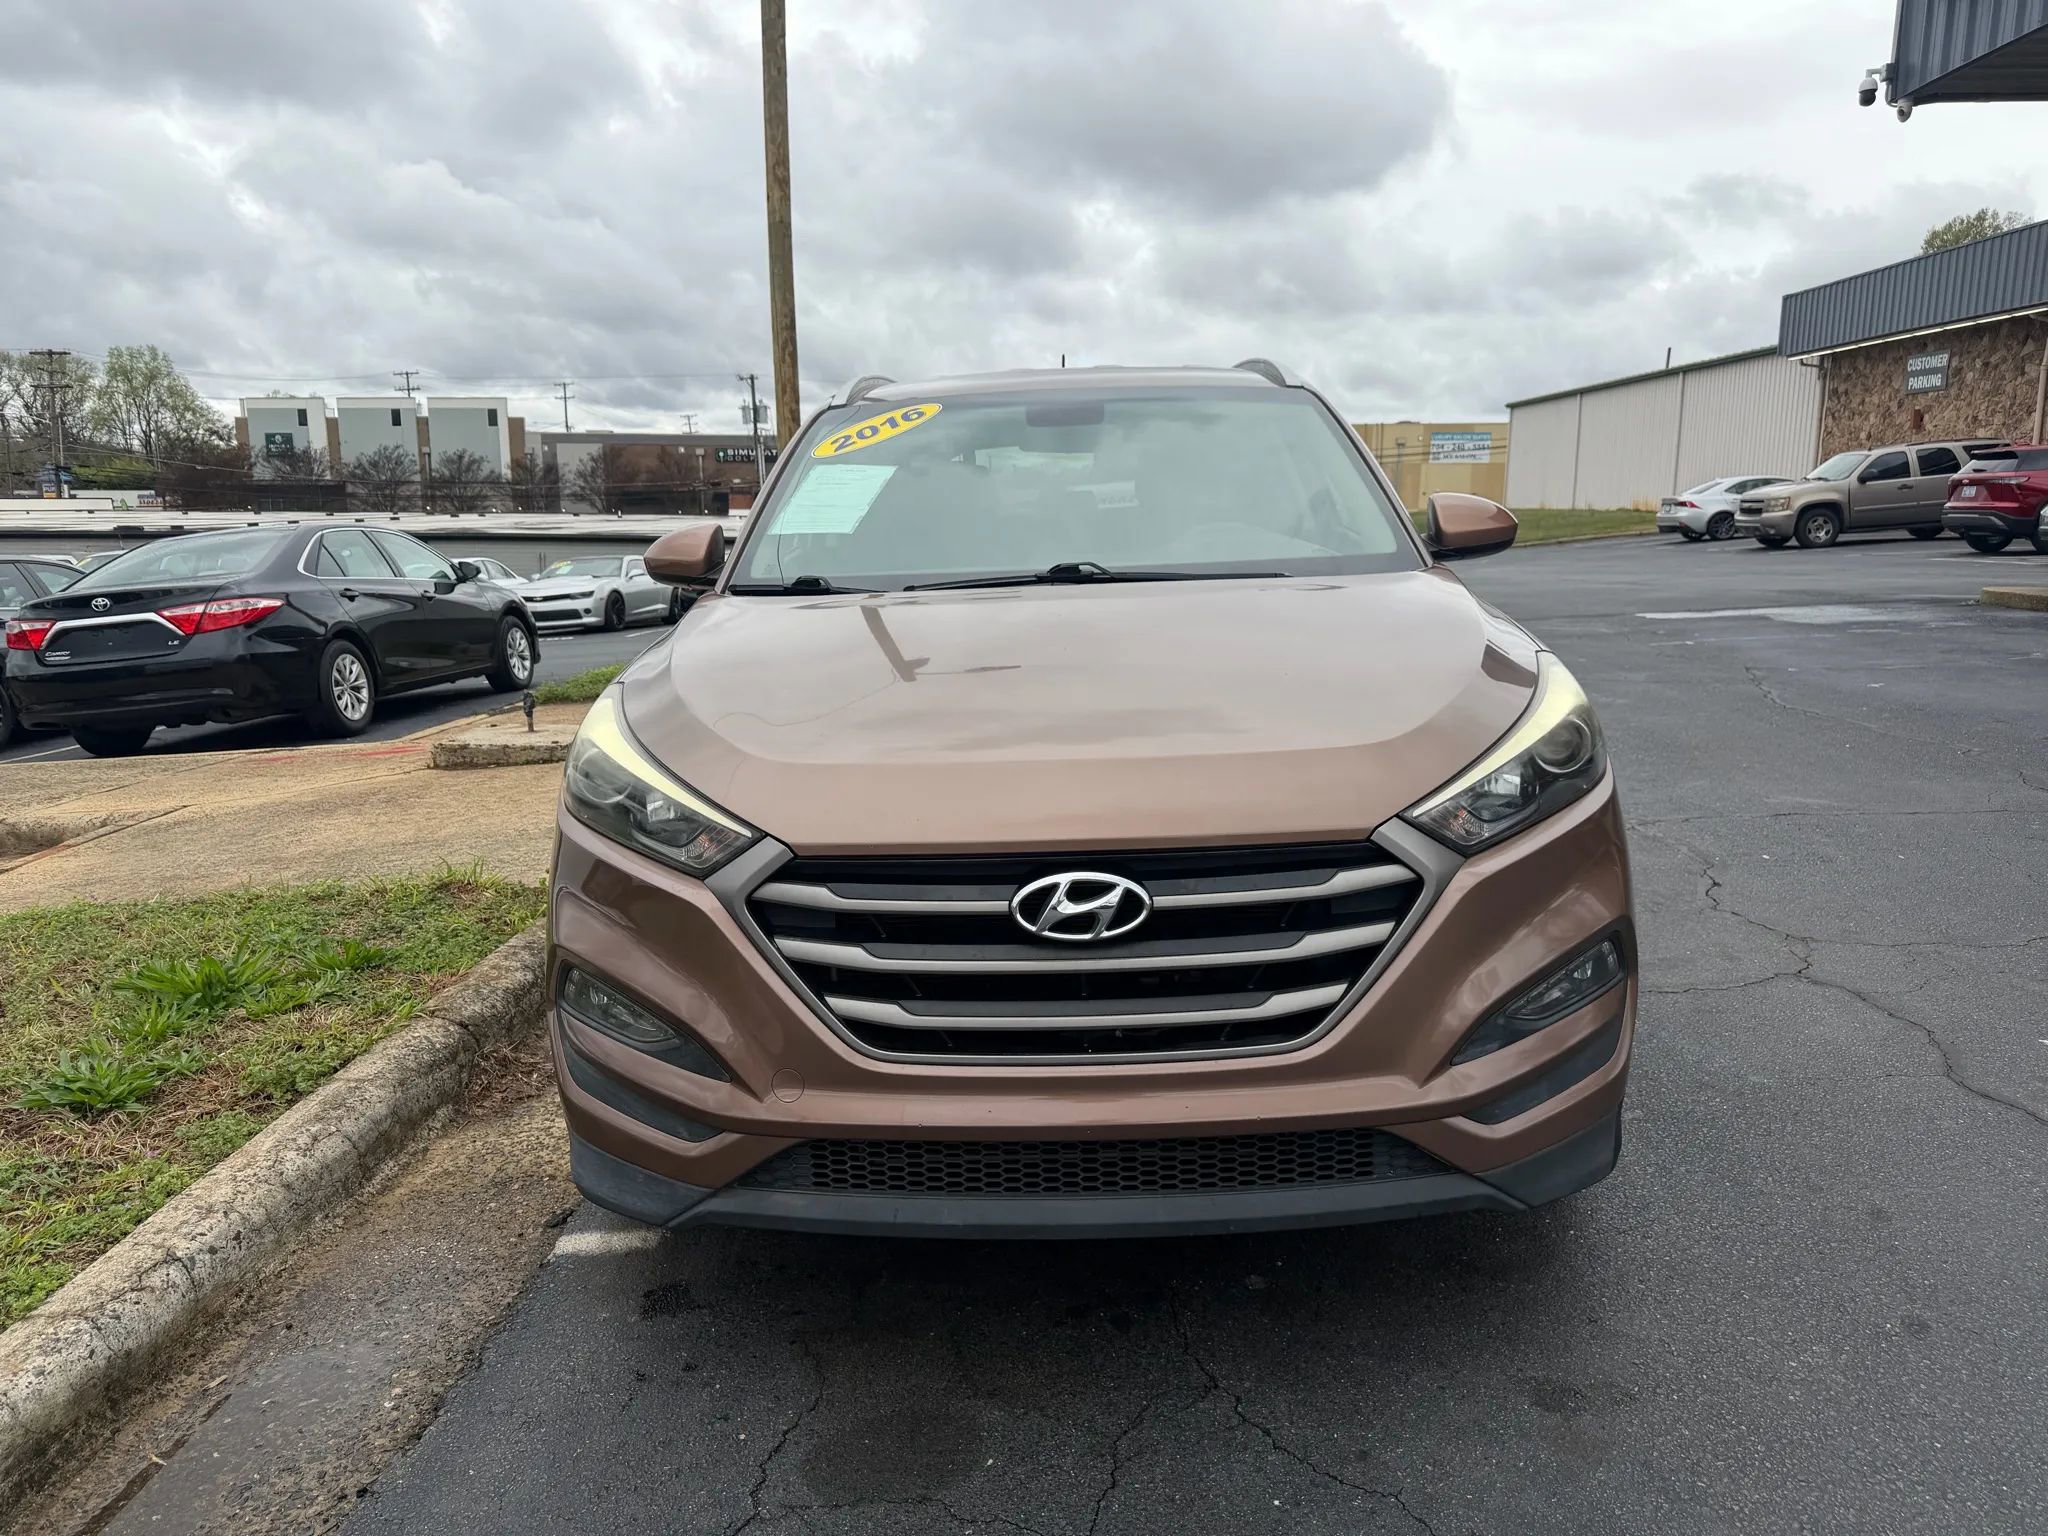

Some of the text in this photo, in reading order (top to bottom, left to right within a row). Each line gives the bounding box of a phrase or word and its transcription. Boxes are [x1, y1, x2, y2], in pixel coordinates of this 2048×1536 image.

[1907, 353, 1948, 371] CUSTOMER
[1908, 374, 1941, 390] PARKING
[830, 407, 926, 453] 2016
